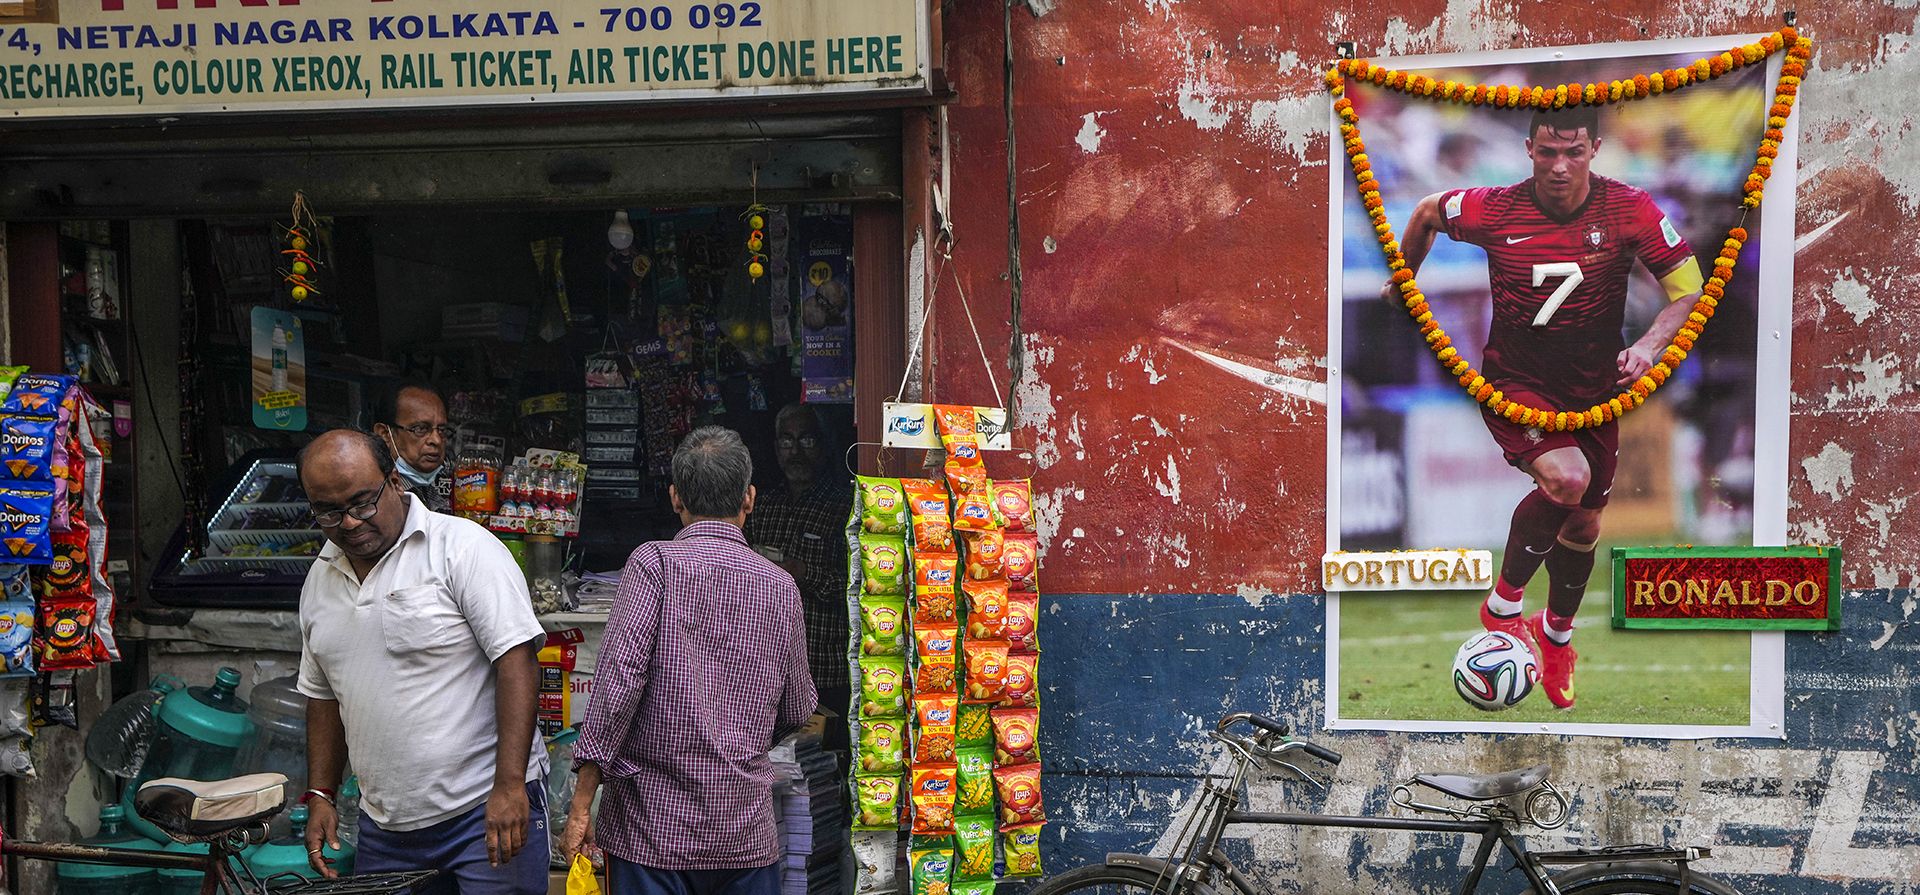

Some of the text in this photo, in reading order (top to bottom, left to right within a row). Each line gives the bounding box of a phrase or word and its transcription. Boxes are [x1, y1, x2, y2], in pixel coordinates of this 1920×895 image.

[0, 27, 41, 56] 4,
[57, 23, 197, 50] NETAJI
[213, 18, 354, 46] NAGAR
[368, 11, 560, 41] KOLKATA
[600, 6, 672, 33] 700
[688, 2, 762, 30] 092
[0, 35, 903, 104] RECHARGE, COLOUR XEROX, RAIL TICKET, AIR TICKET DONE HERE
[1531, 262, 1585, 327] 7
[636, 340, 661, 354] GEMS
[19, 378, 60, 388] Doritos
[977, 423, 1004, 433] Dorito
[2, 434, 44, 446] Doritos
[0, 512, 41, 524] Doritos
[1324, 556, 1491, 586] PORTUGAL
[1633, 578, 1821, 607] RONALDO
[570, 678, 593, 694] airt
